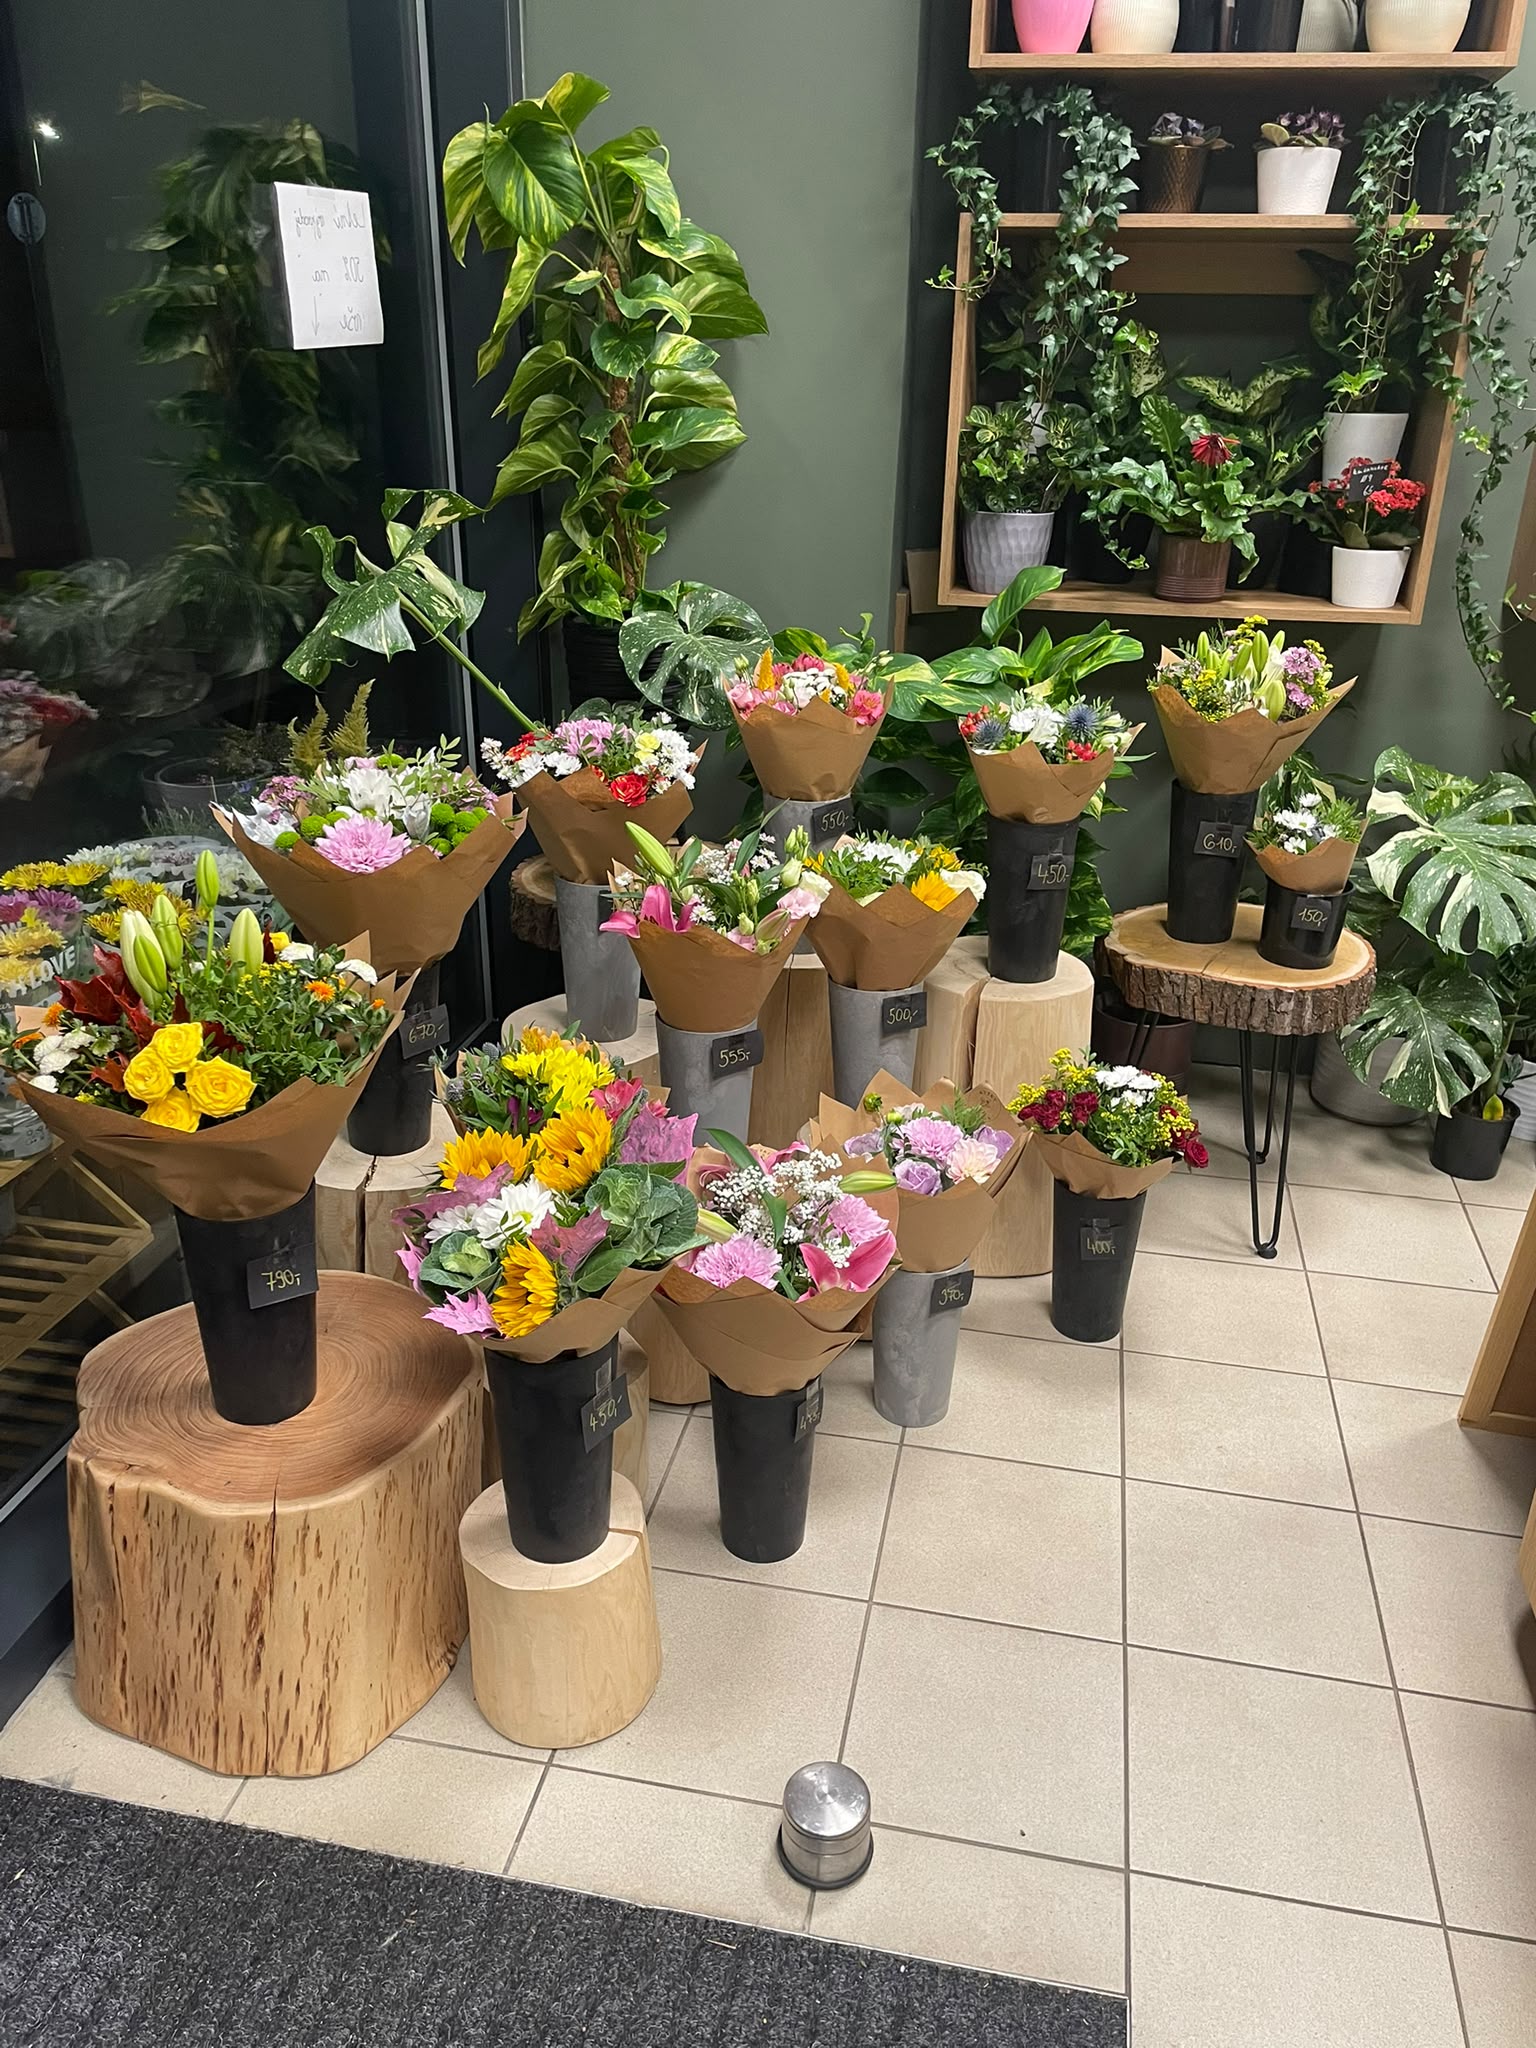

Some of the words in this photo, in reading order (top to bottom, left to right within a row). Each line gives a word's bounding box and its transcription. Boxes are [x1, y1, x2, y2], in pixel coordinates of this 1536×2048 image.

[821, 810, 849, 831] 550,-
[1203, 833, 1237, 853] 610,-
[1298, 908, 1328, 927] 150,-
[29, 944, 77, 990] LOVE
[887, 1007, 918, 1024] 500,-
[718, 1048, 751, 1068] 555,-
[261, 1269, 301, 1292] 790,-
